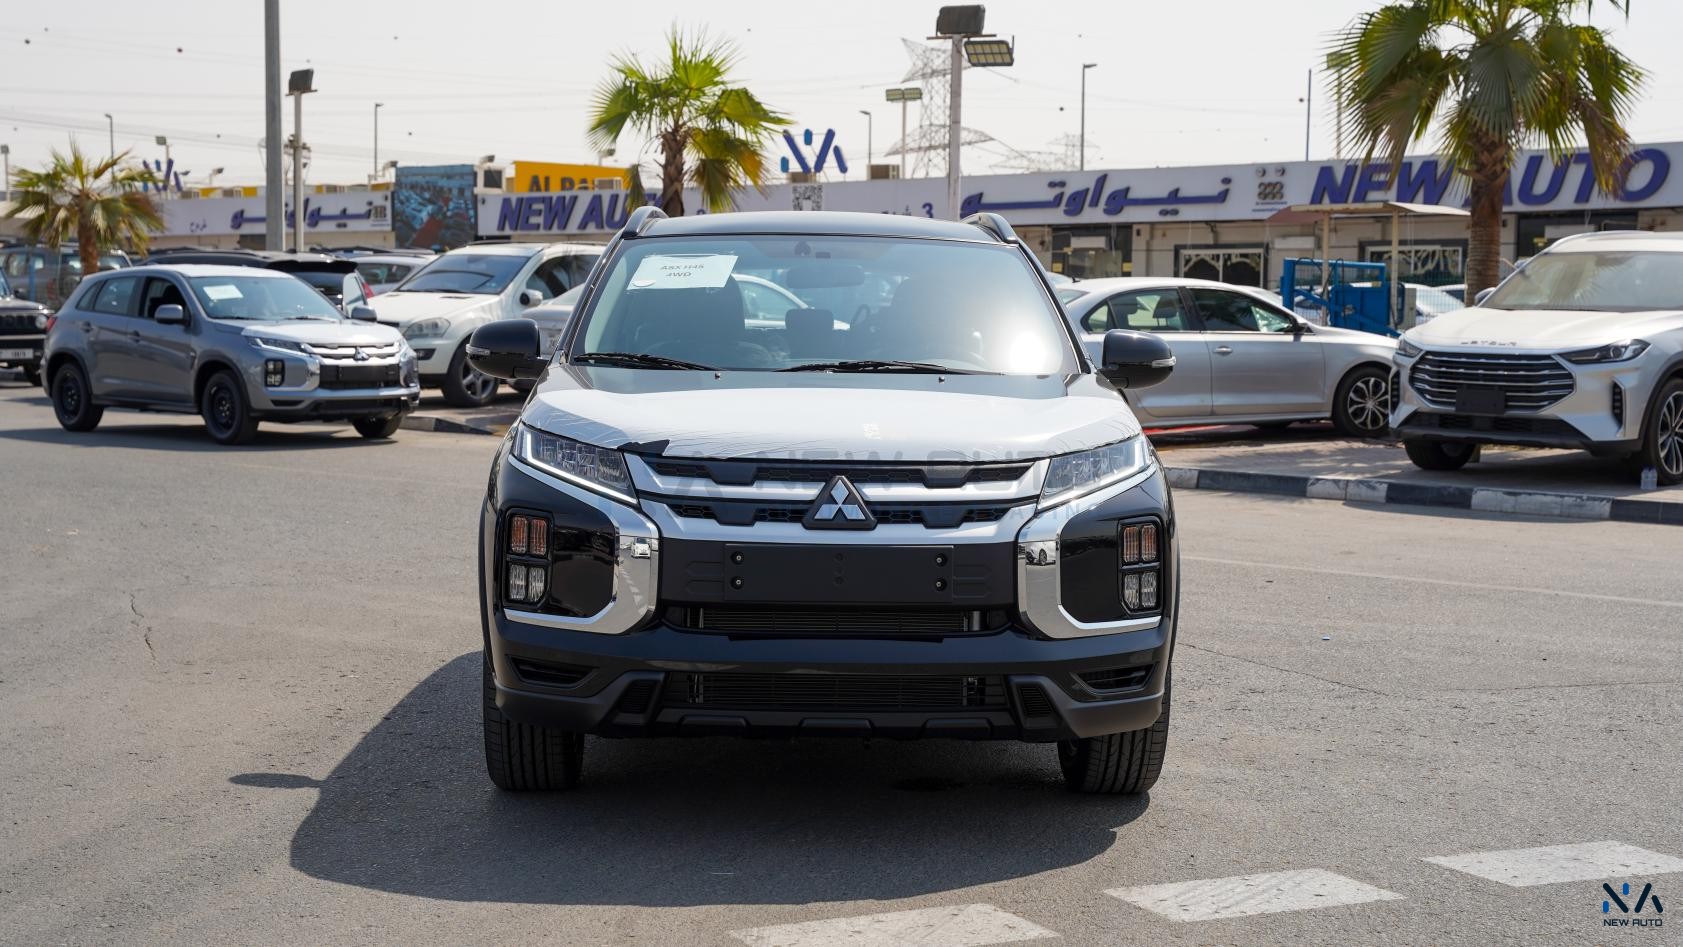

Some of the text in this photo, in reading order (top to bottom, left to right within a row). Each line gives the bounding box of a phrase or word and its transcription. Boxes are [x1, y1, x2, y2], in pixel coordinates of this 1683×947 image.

[1310, 148, 1671, 208] NEW UTO
[497, 194, 577, 232] NEW
